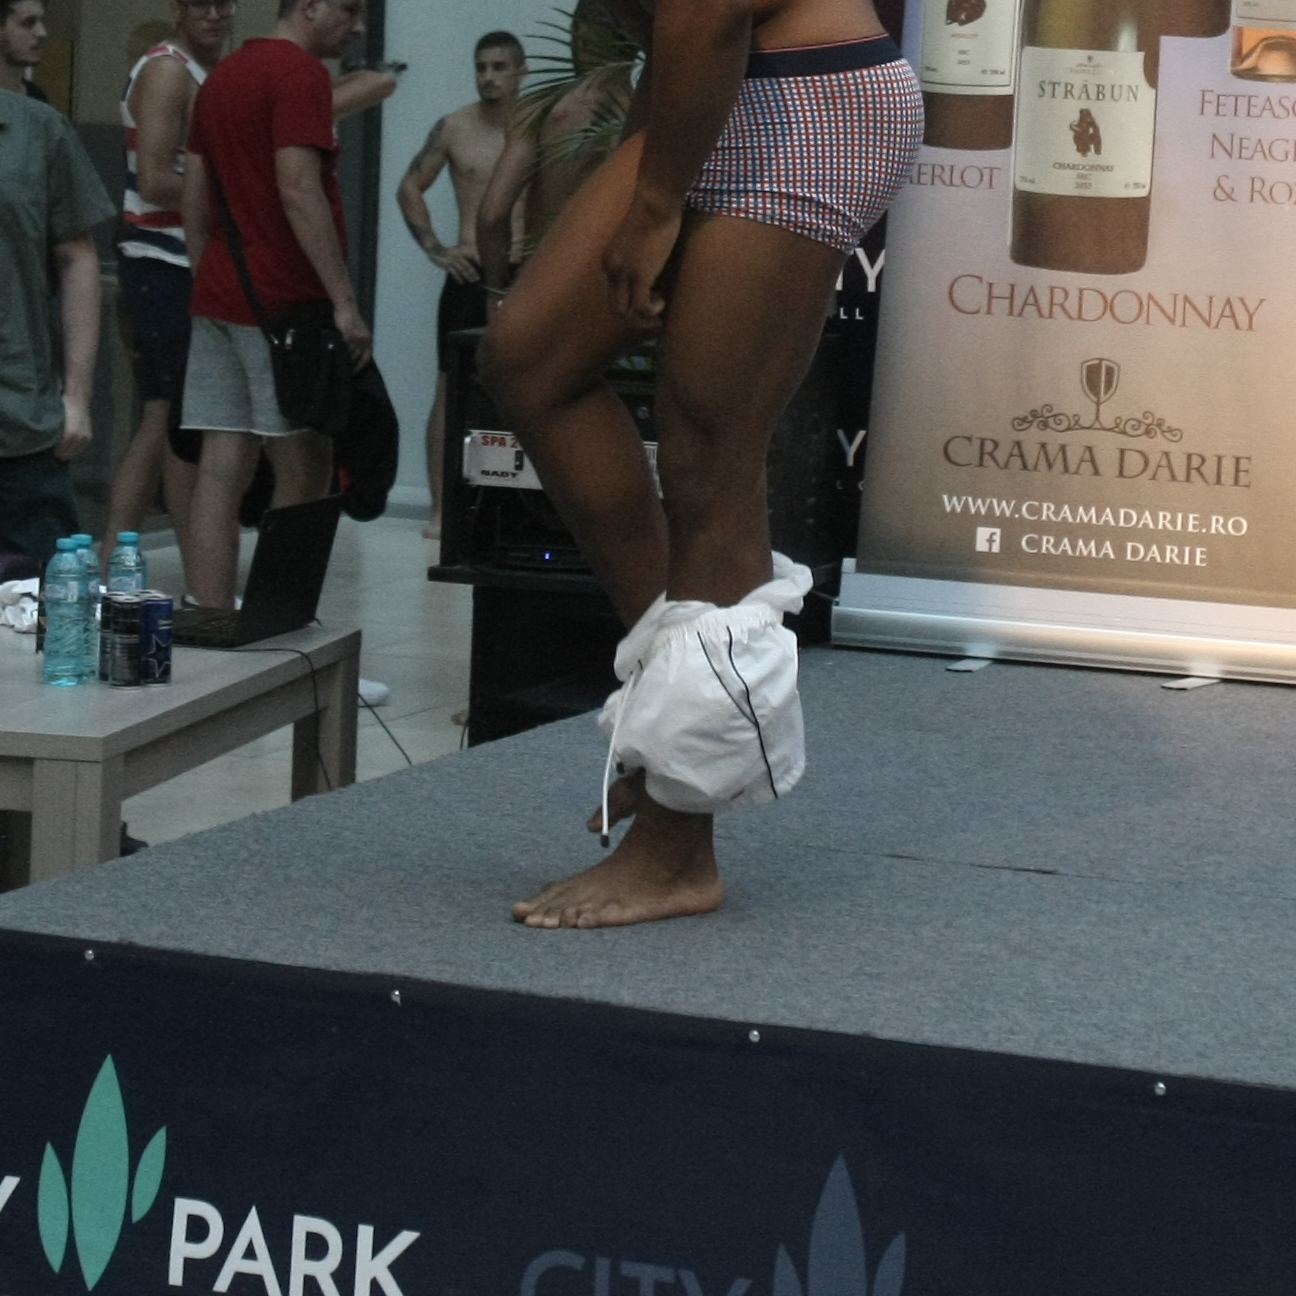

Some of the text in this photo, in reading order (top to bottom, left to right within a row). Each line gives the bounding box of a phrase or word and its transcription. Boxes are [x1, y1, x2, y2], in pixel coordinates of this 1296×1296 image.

[1212, 176, 1239, 204] &
[947, 273, 1267, 333] CHARDONNAY
[942, 433, 1253, 489] CRAMA DARIE
[941, 492, 1249, 538] WWW.CRAMADARIE.RO
[1021, 532, 1209, 567] CRAMA DARIE
[168, 1196, 422, 1296] PARK
